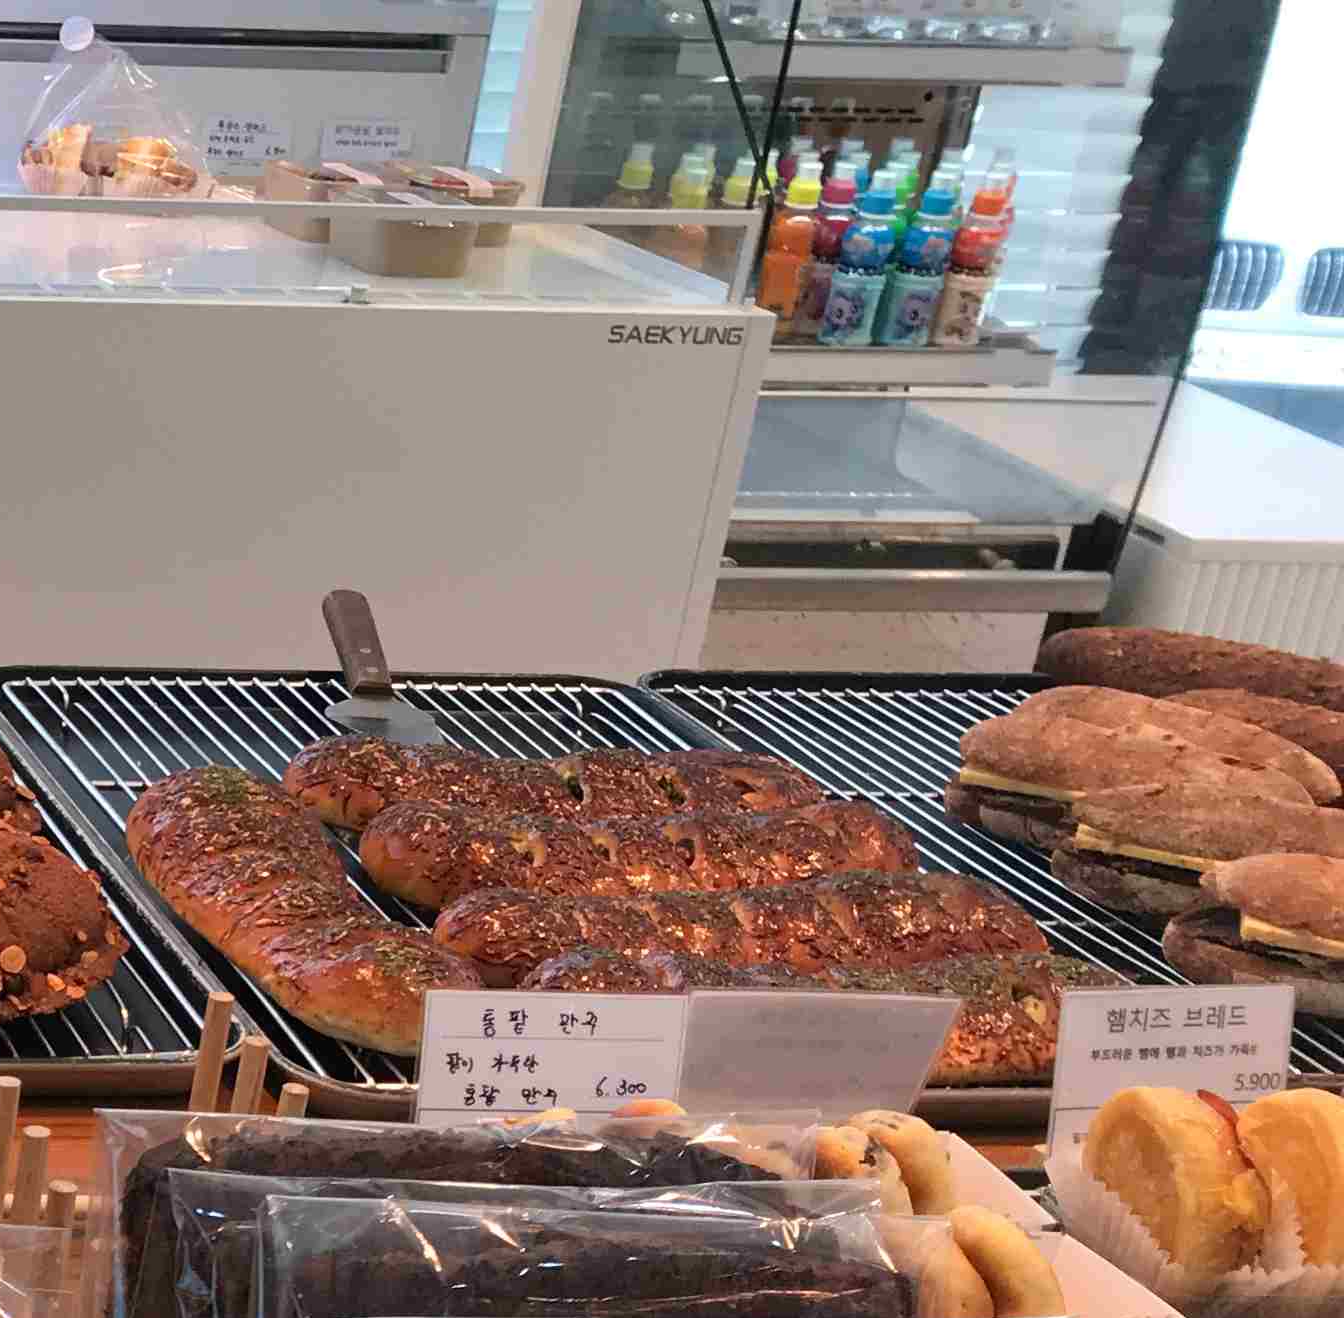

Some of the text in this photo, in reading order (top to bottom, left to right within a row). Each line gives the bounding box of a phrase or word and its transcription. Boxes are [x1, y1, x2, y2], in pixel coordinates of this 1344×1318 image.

[607, 324, 745, 346] SAEKYUNG
[1106, 1003, 1249, 1033] 햄치즈 브레드
[1233, 1071, 1282, 1092] 5.900
